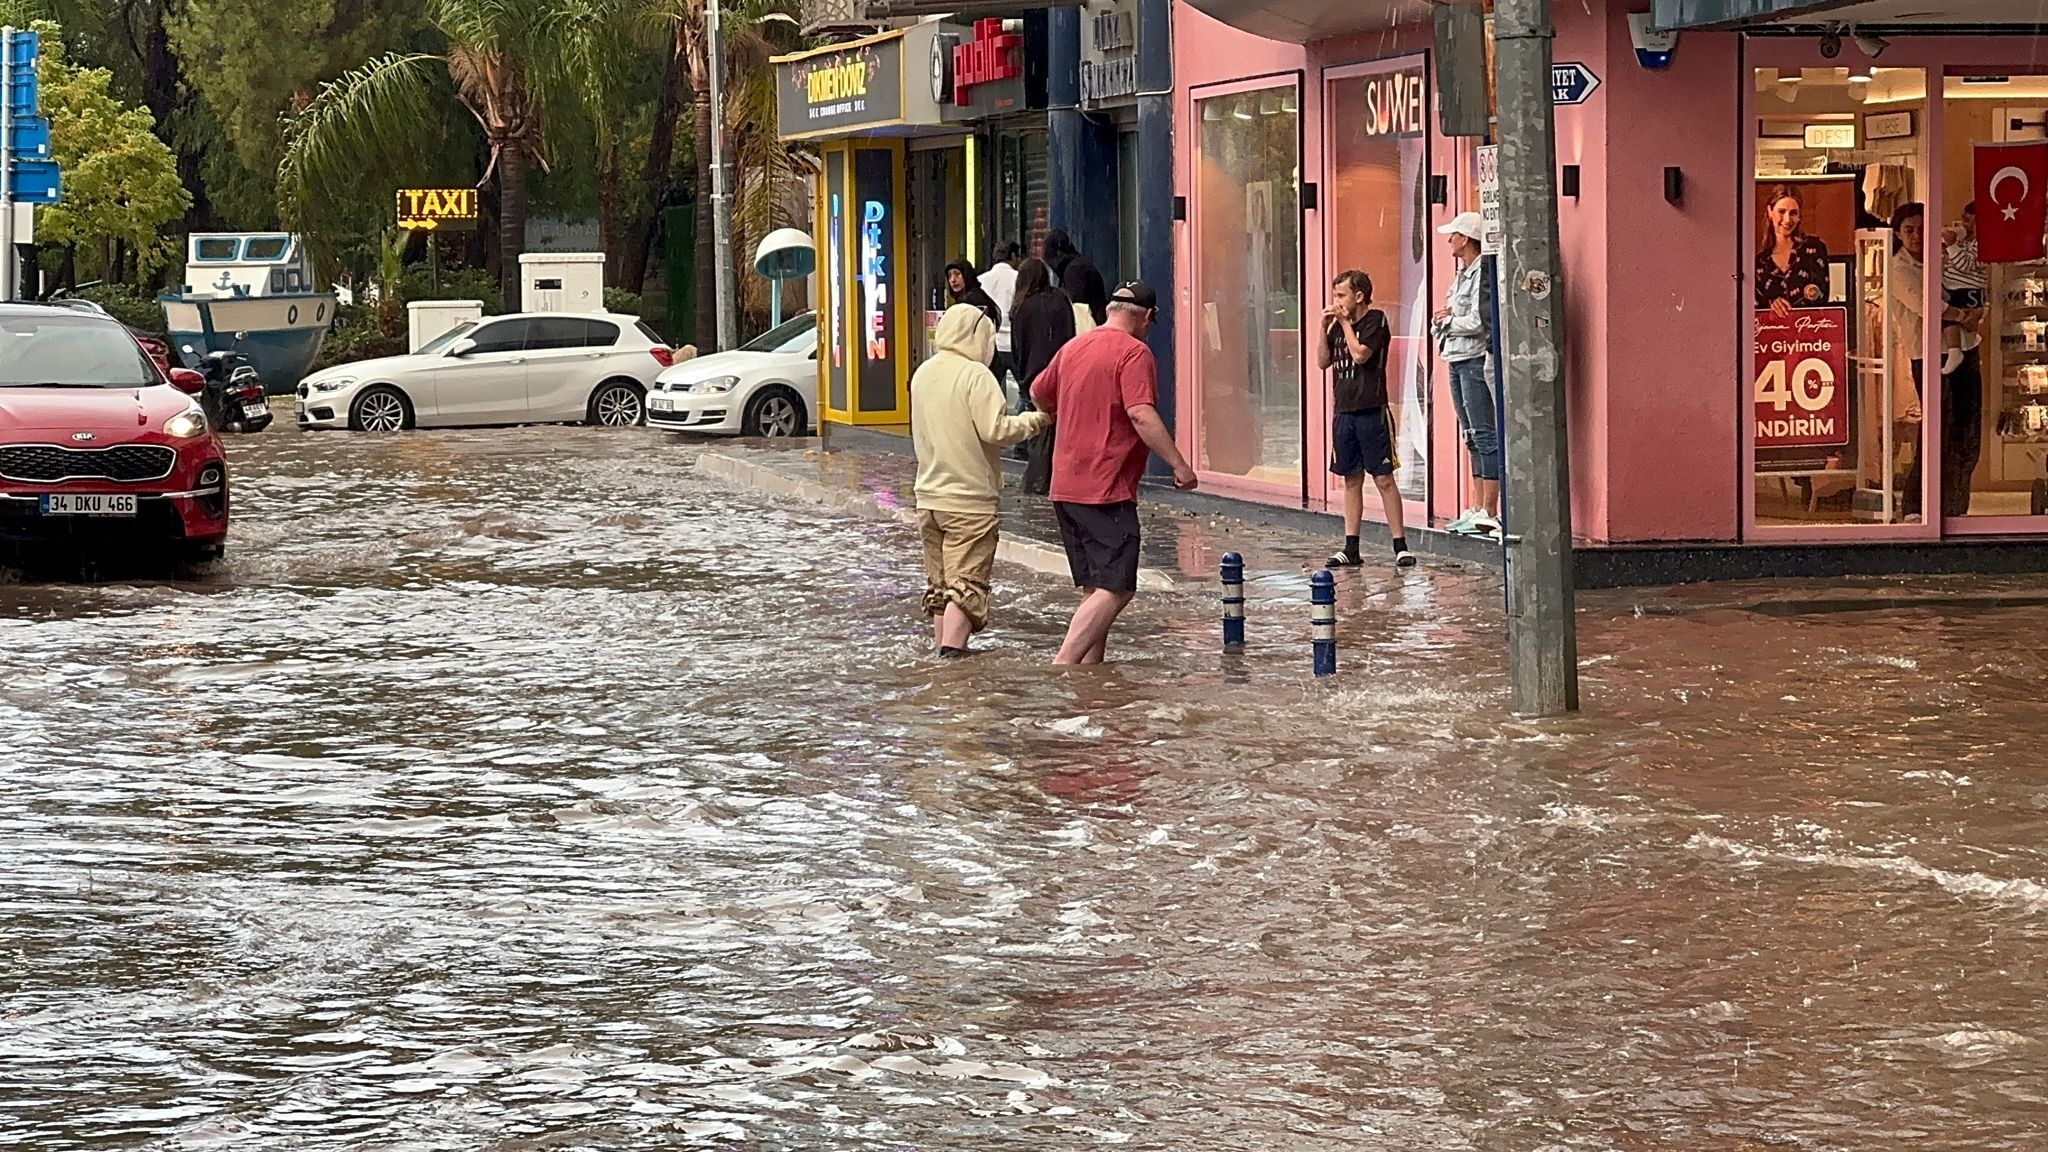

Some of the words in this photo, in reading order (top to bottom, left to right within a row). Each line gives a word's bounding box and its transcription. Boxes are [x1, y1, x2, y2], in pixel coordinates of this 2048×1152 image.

[405, 191, 468, 215] TAXI
[1771, 339, 1831, 355] Giyimde
[1755, 357, 1835, 411] 40
[51, 496, 68, 511] 34
[75, 496, 101, 511] DKU
[108, 496, 133, 511] 466
